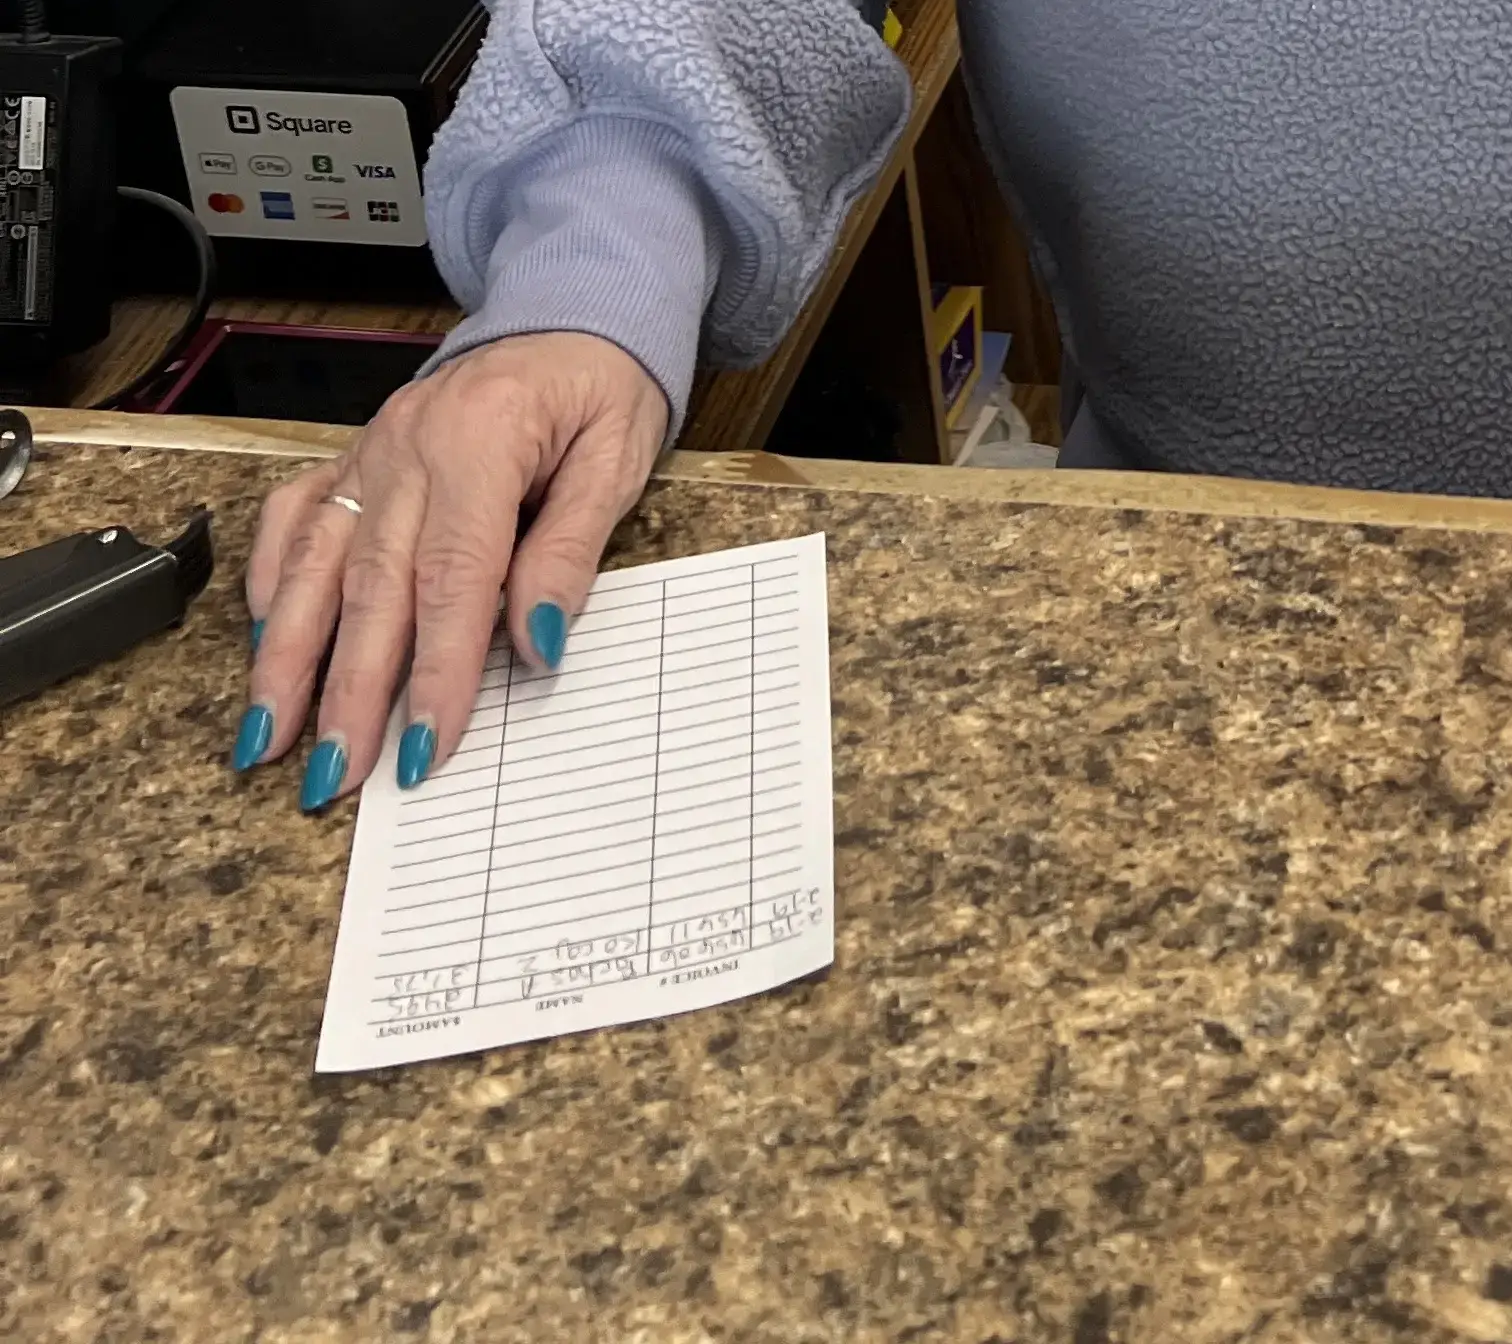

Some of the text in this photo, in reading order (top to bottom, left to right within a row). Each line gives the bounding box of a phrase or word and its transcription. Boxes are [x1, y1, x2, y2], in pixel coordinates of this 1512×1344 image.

[265, 111, 353, 136] Square
[353, 163, 397, 179] VISA
[670, 960, 739, 985] INVOICE
[534, 994, 583, 1012] NAME
